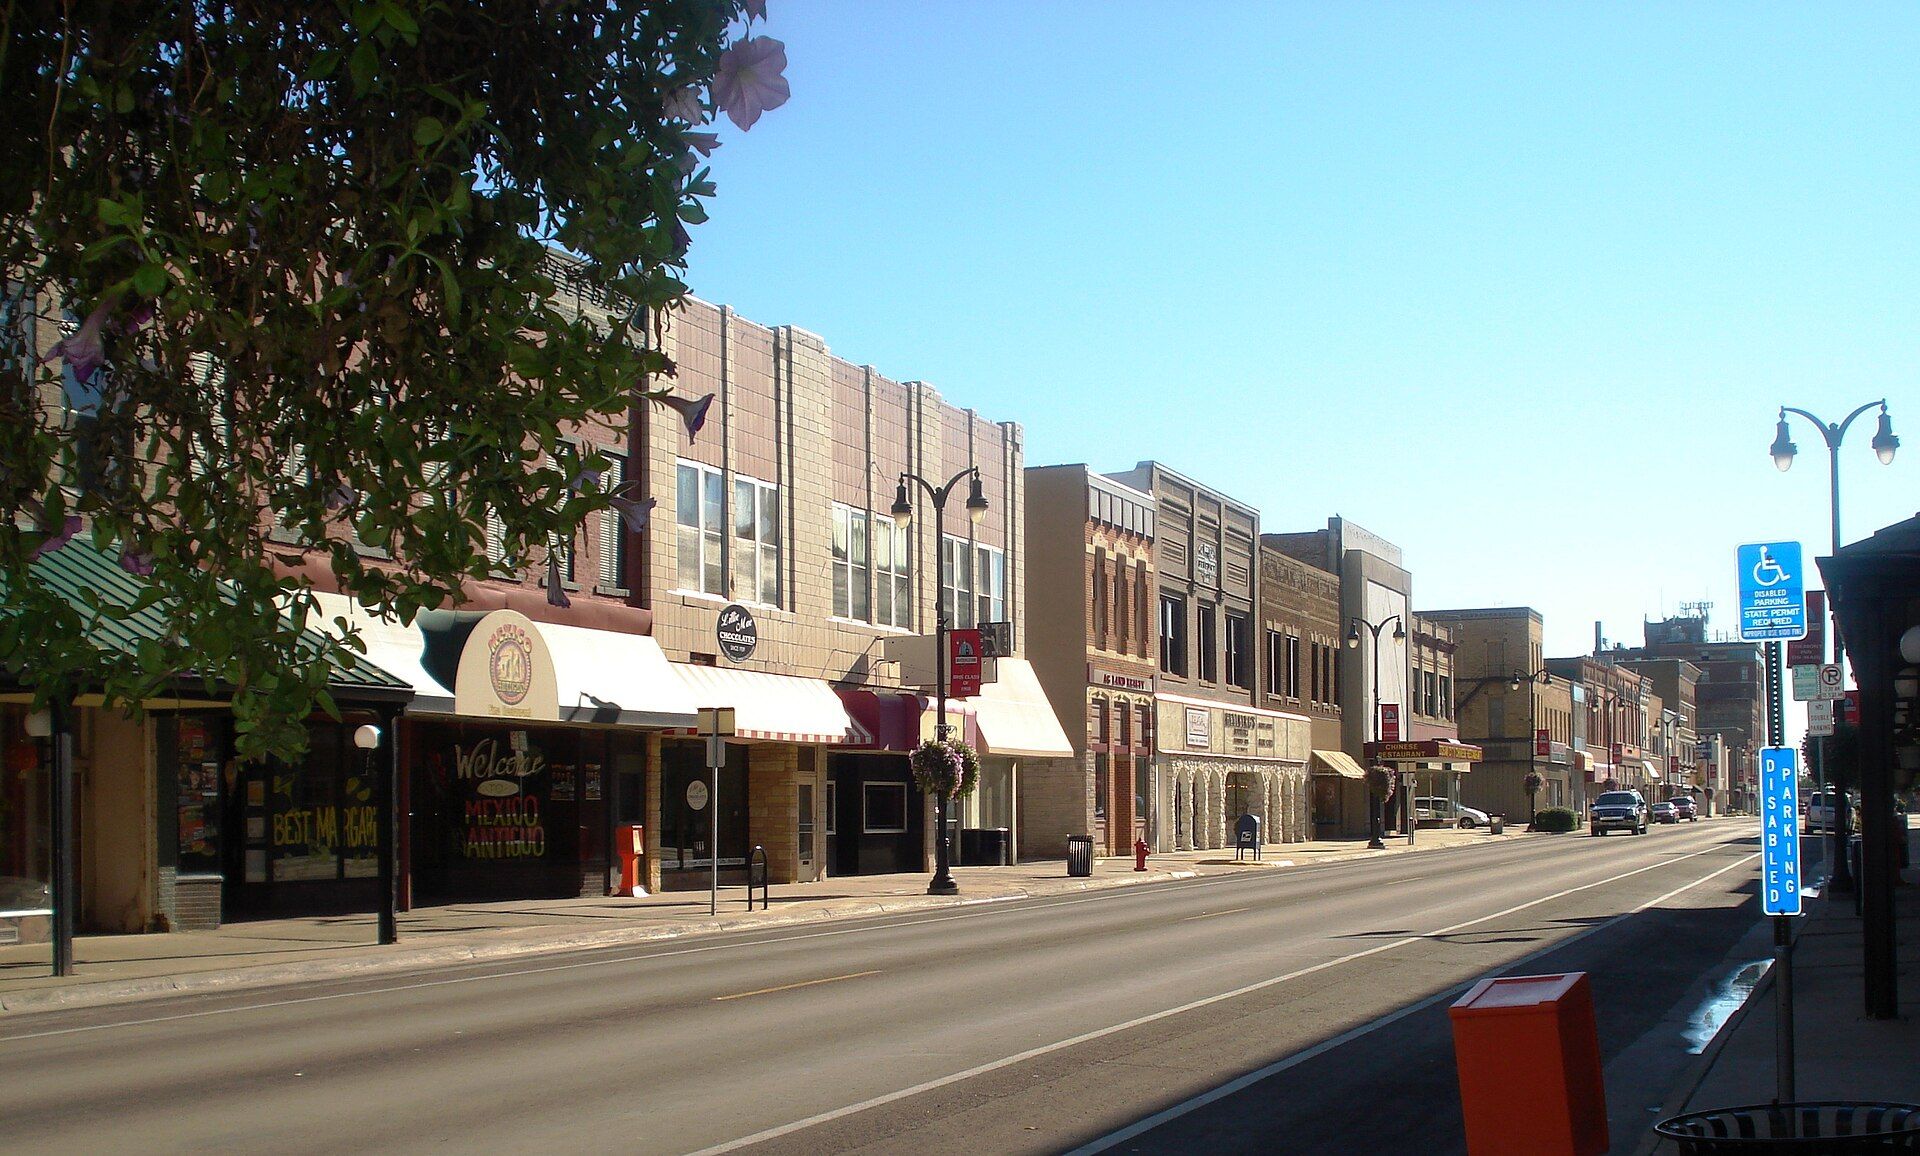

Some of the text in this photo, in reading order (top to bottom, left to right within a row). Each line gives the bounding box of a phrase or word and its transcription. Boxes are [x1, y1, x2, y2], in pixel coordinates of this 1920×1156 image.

[1754, 589, 1787, 598] DISABLED
[1754, 597, 1789, 606] PARKING
[1744, 608, 1800, 618] STATE PERMIT
[1752, 617, 1792, 626] REQUIRED
[488, 623, 533, 654] MEXICO
[719, 631, 756, 644] CHOCOLATES
[465, 796, 539, 826] MEXICO
[273, 811, 311, 846] BEST
[465, 826, 545, 858] ANTIGUO
[1766, 759, 1779, 903] DISABLED
[1782, 768, 1794, 893] PARKING
